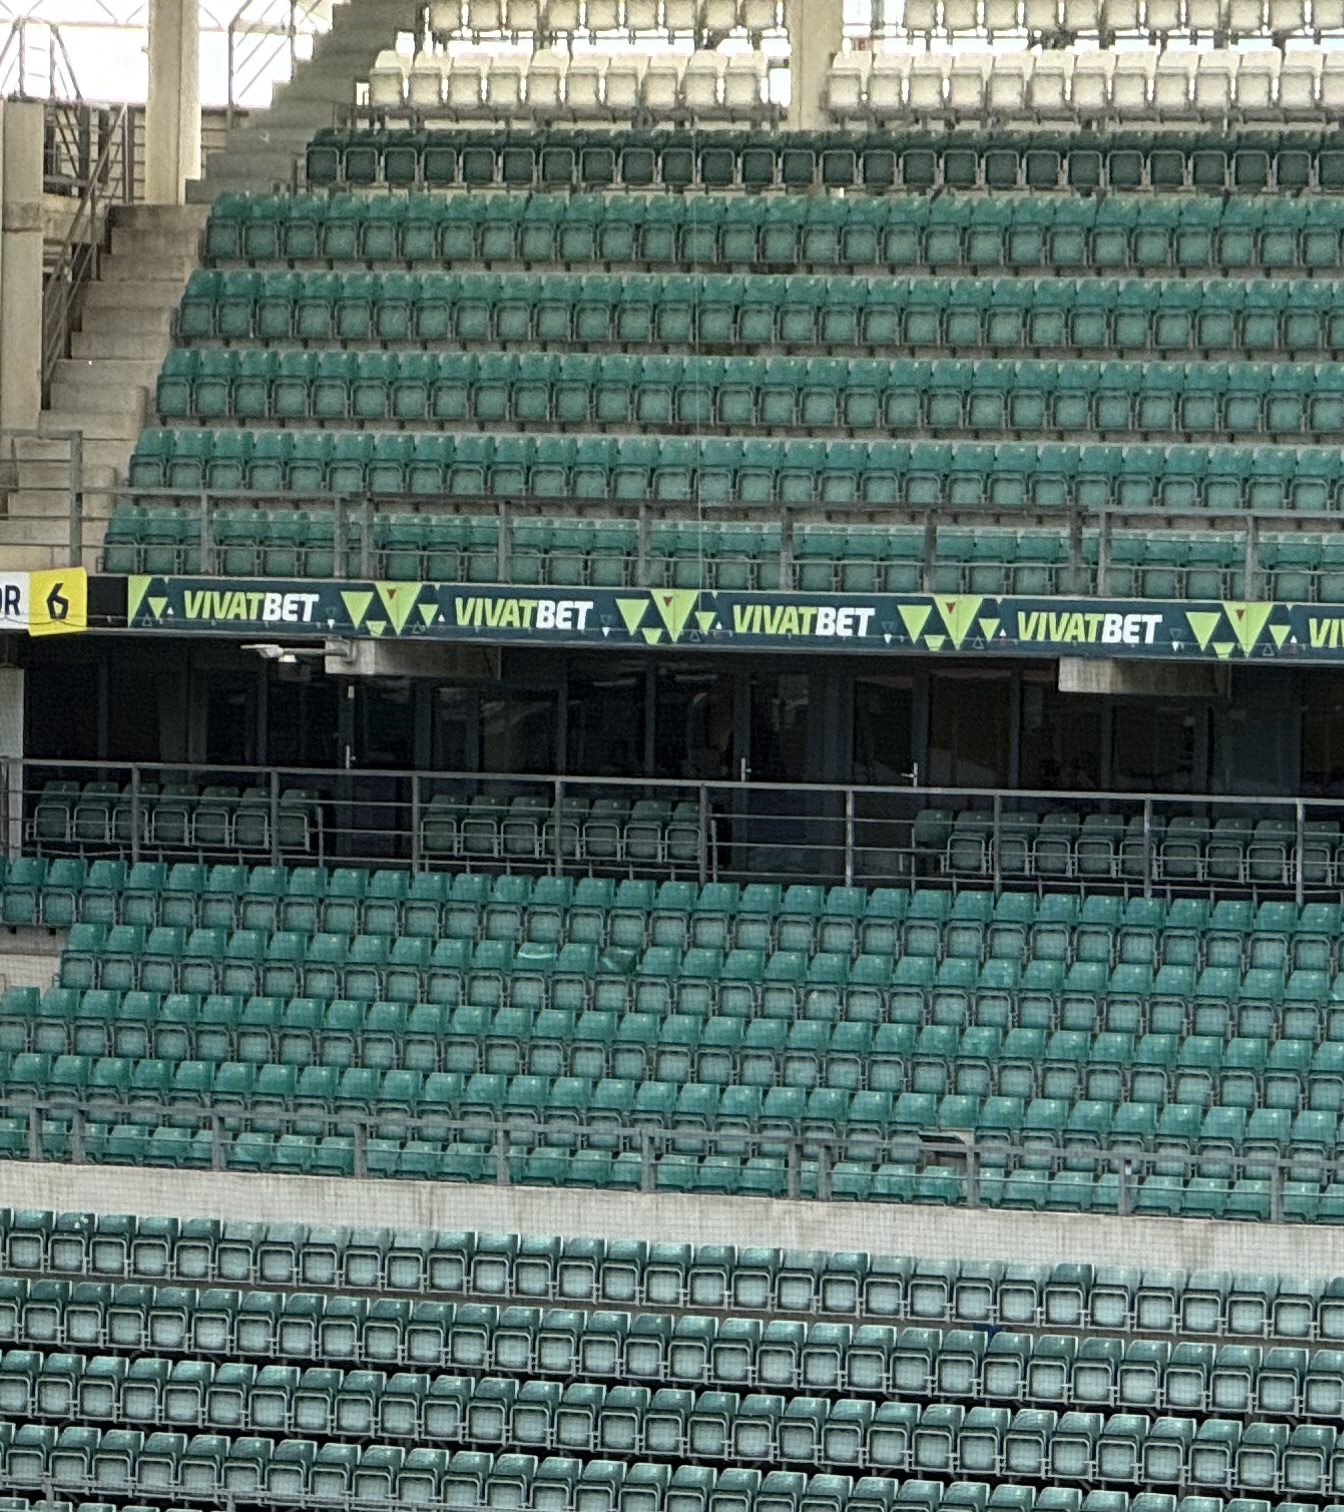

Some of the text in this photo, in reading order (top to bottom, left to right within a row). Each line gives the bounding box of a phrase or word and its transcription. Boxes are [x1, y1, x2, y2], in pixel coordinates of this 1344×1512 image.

[0, 582, 70, 620] R 6
[184, 590, 320, 621] VIVATBET
[455, 597, 594, 629] VIVATBET
[733, 604, 876, 637] VIVATBET
[1017, 611, 1163, 644] VIVATBET
